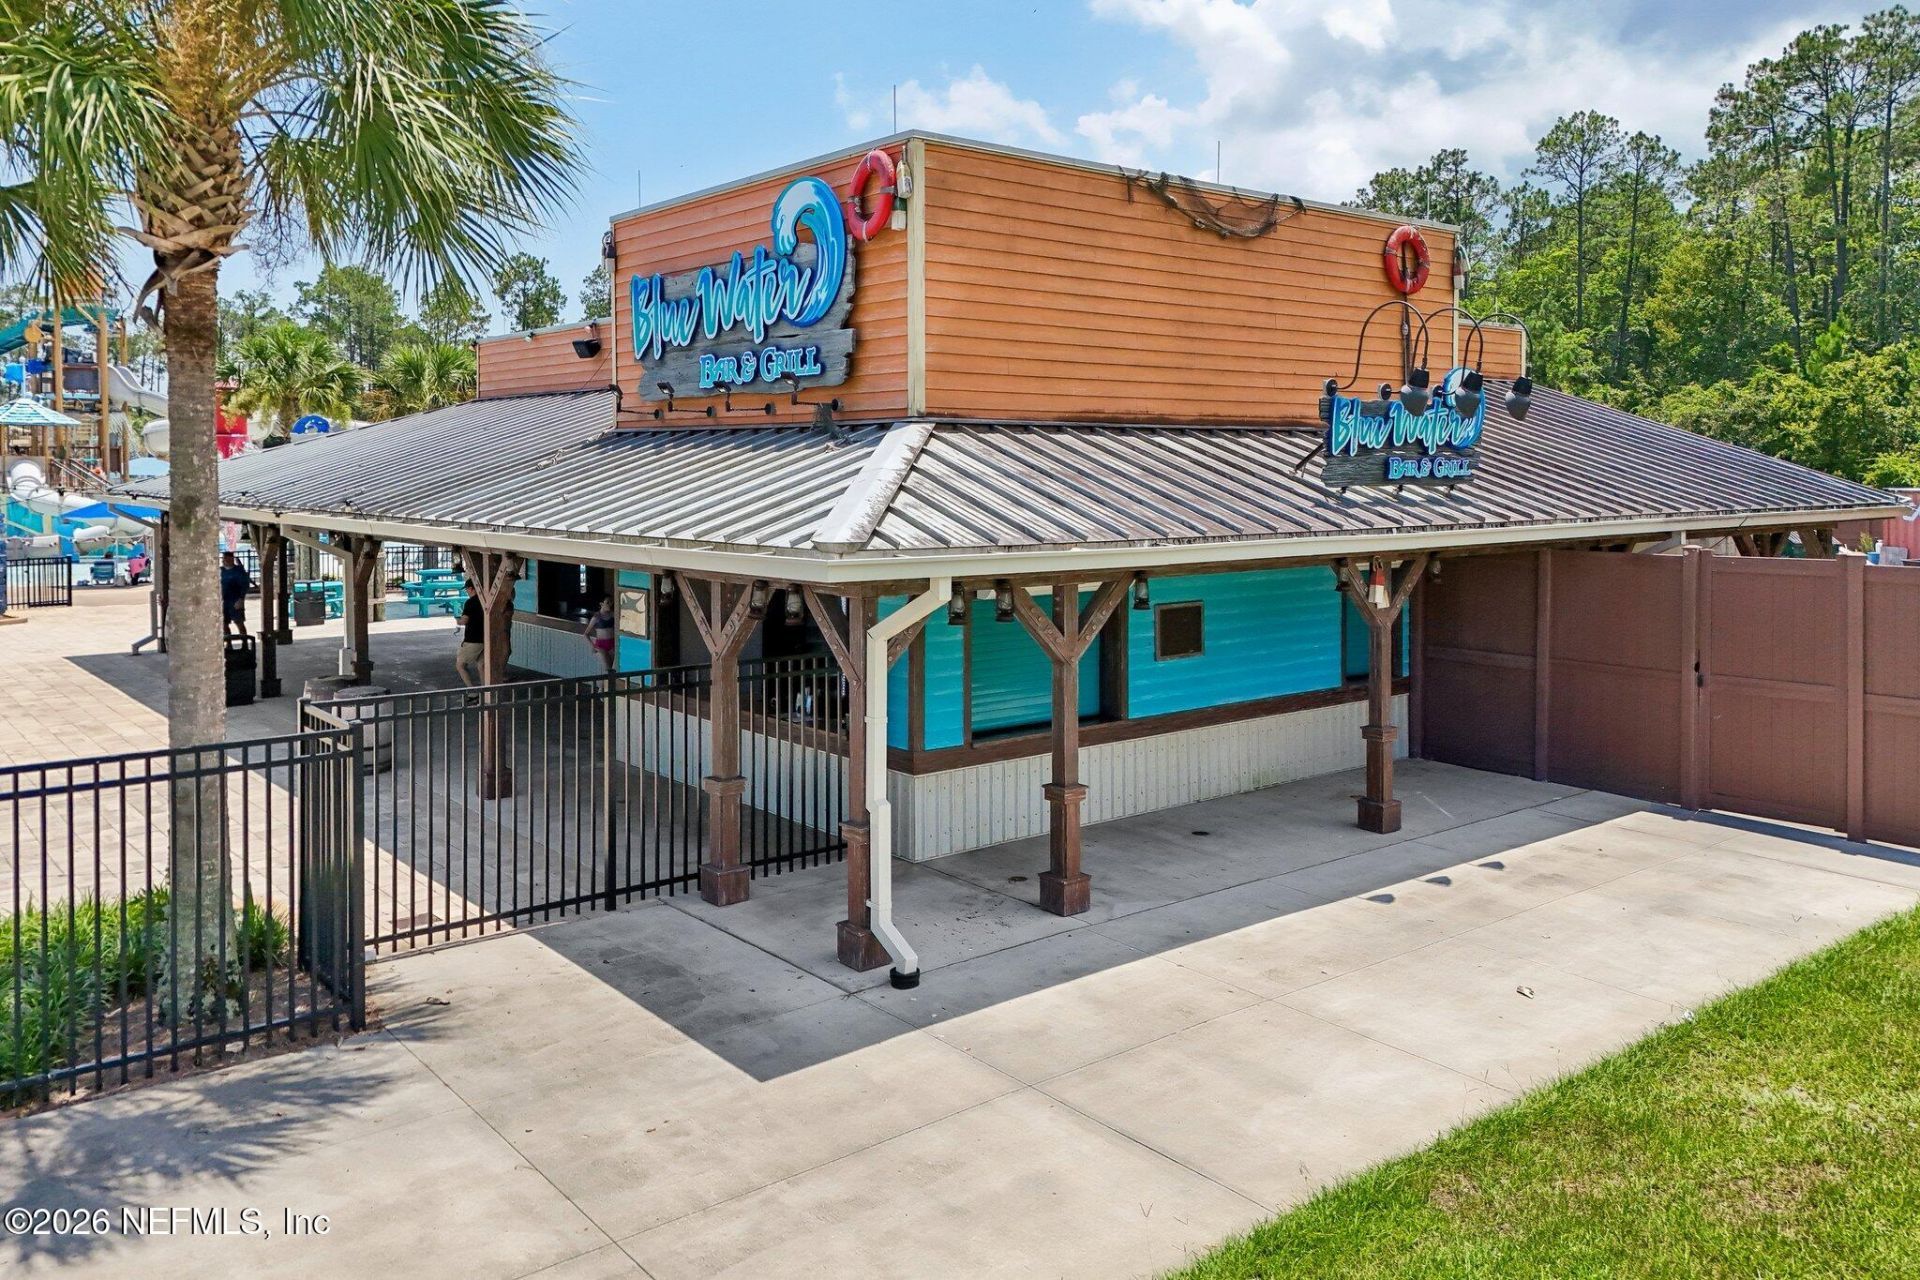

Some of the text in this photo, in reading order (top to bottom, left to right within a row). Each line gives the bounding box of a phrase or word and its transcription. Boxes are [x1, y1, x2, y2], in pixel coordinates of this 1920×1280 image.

[630, 245, 811, 360] Blue Water
[741, 351, 756, 384] &
[1332, 396, 1470, 457] Blue Water
[1420, 457, 1432, 477] &
